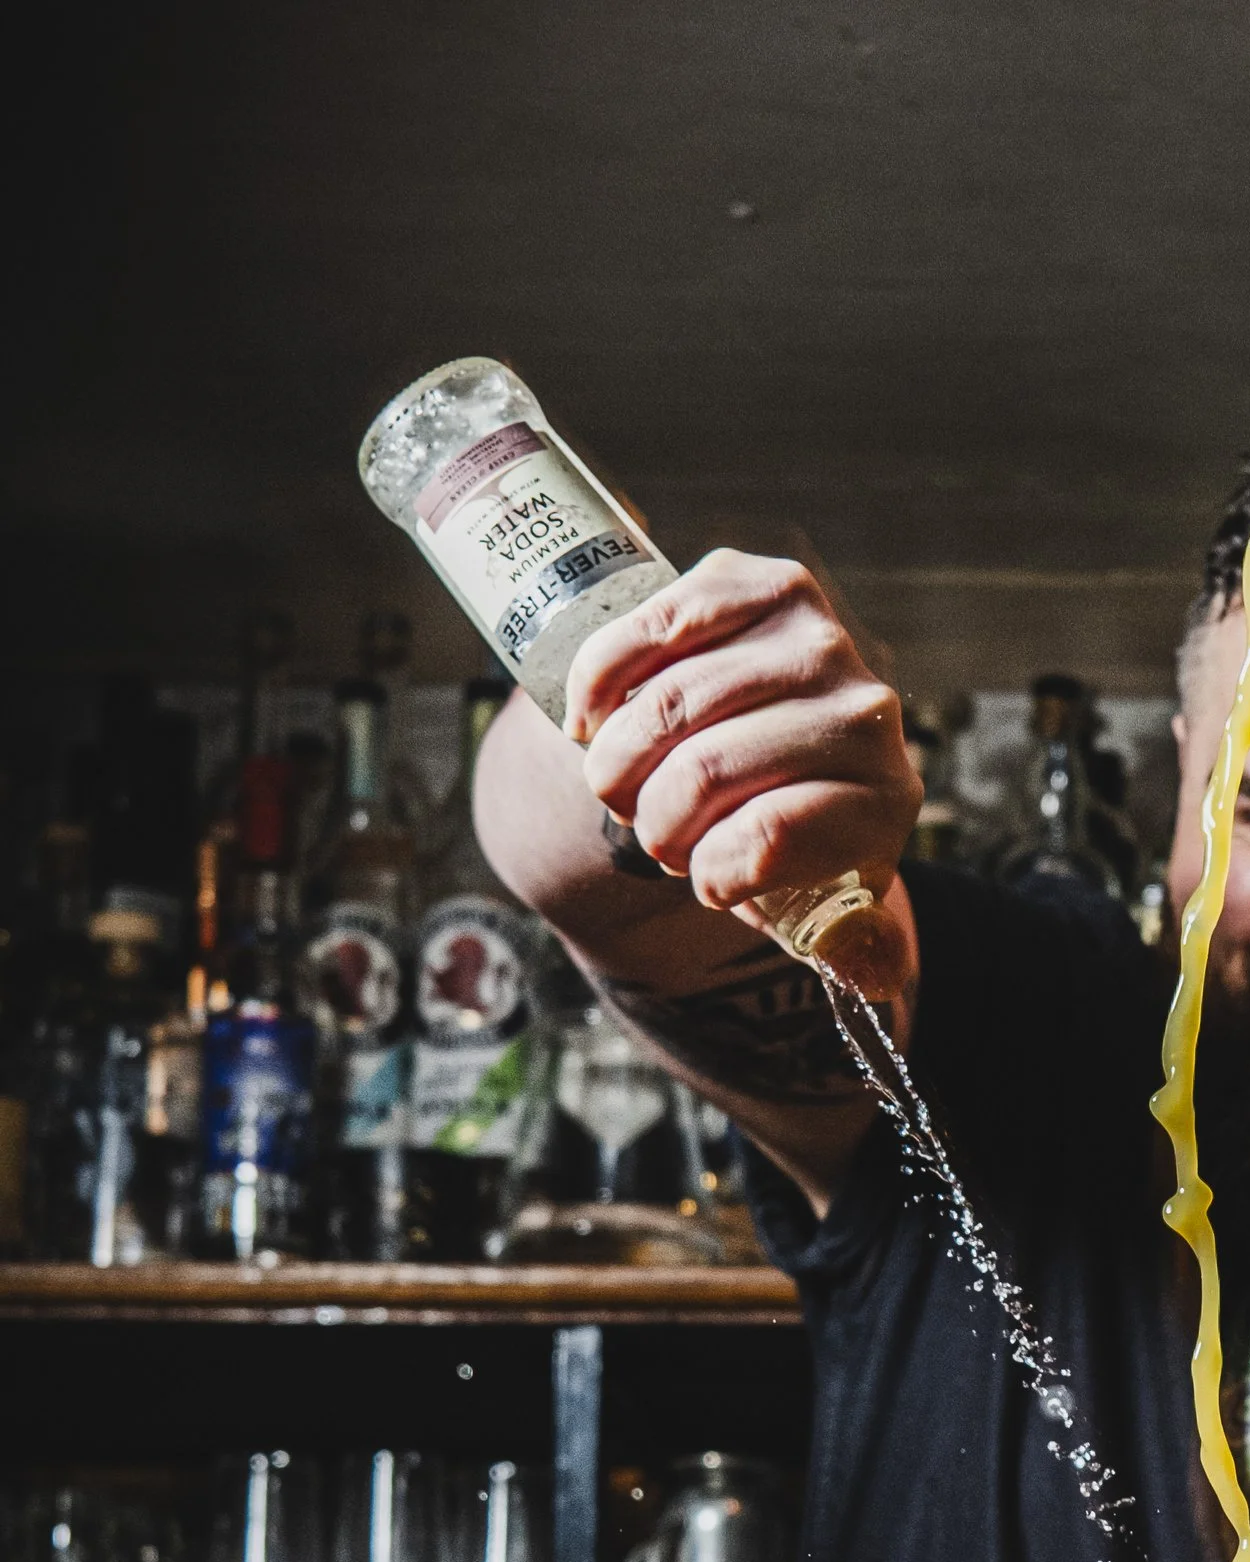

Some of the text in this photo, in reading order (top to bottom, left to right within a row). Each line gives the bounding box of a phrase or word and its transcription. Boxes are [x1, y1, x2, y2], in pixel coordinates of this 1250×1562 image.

[479, 492, 556, 551] WATER
[499, 511, 564, 561] SODA
[510, 526, 579, 584] PREMIUM
[503, 535, 639, 645] FEVER-TREE
